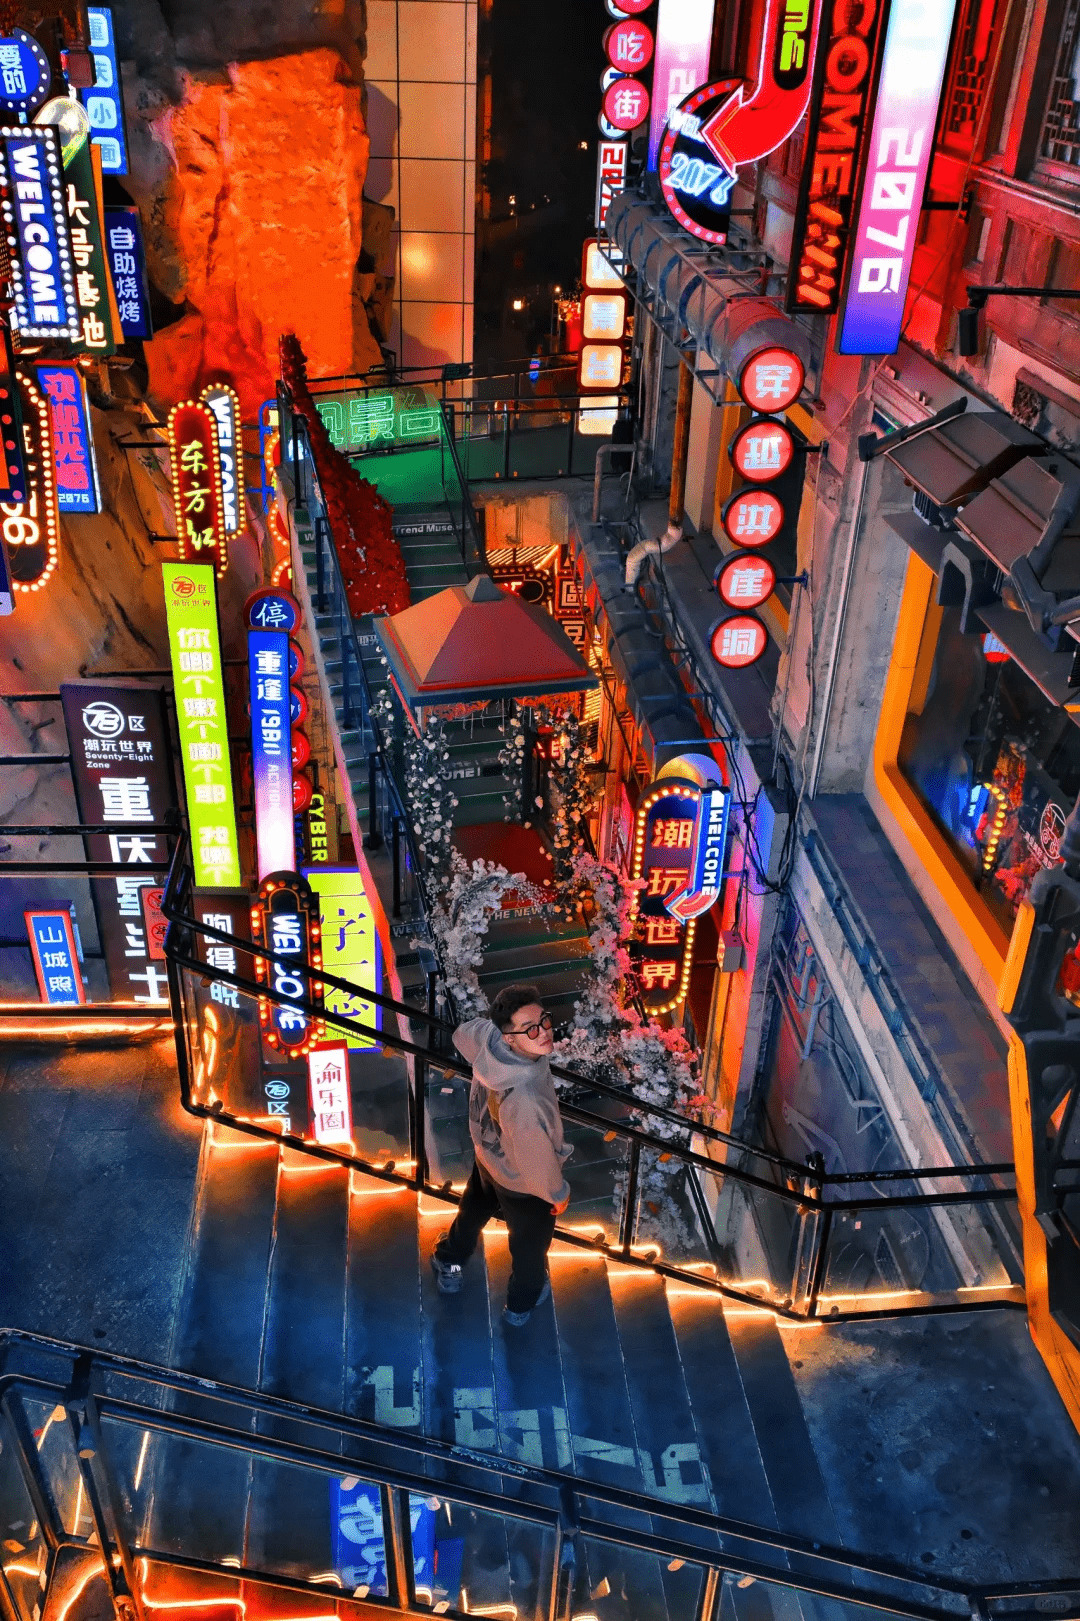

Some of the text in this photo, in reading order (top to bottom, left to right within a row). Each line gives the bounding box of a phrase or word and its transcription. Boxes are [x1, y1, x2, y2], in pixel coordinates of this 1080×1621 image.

[663, 152, 738, 205] 2076
[857, 127, 924, 294] 2076
[12, 144, 60, 323] WELCOME
[109, 227, 141, 323] 自助烧烤
[181, 440, 216, 551] 东方红
[208, 395, 237, 531] WELCOME
[58, 494, 90, 504] 2076
[721, 364, 793, 657] 穿越洪崖洞
[172, 578, 194, 596] 78
[82, 705, 146, 735] 78 区
[83, 739, 152, 753] 潮玩世界
[85, 752, 153, 762] Seventy-Eight
[86, 761, 110, 769] Zone
[308, 793, 329, 863] CYBER
[702, 810, 722, 896] WELCOME
[642, 818, 693, 990] 潮玩世界
[39, 926, 78, 1004] 山城照
[265, 1082, 289, 1098] 78
[267, 1101, 290, 1115] 区
[317, 1061, 346, 1132] 渝乐圈
